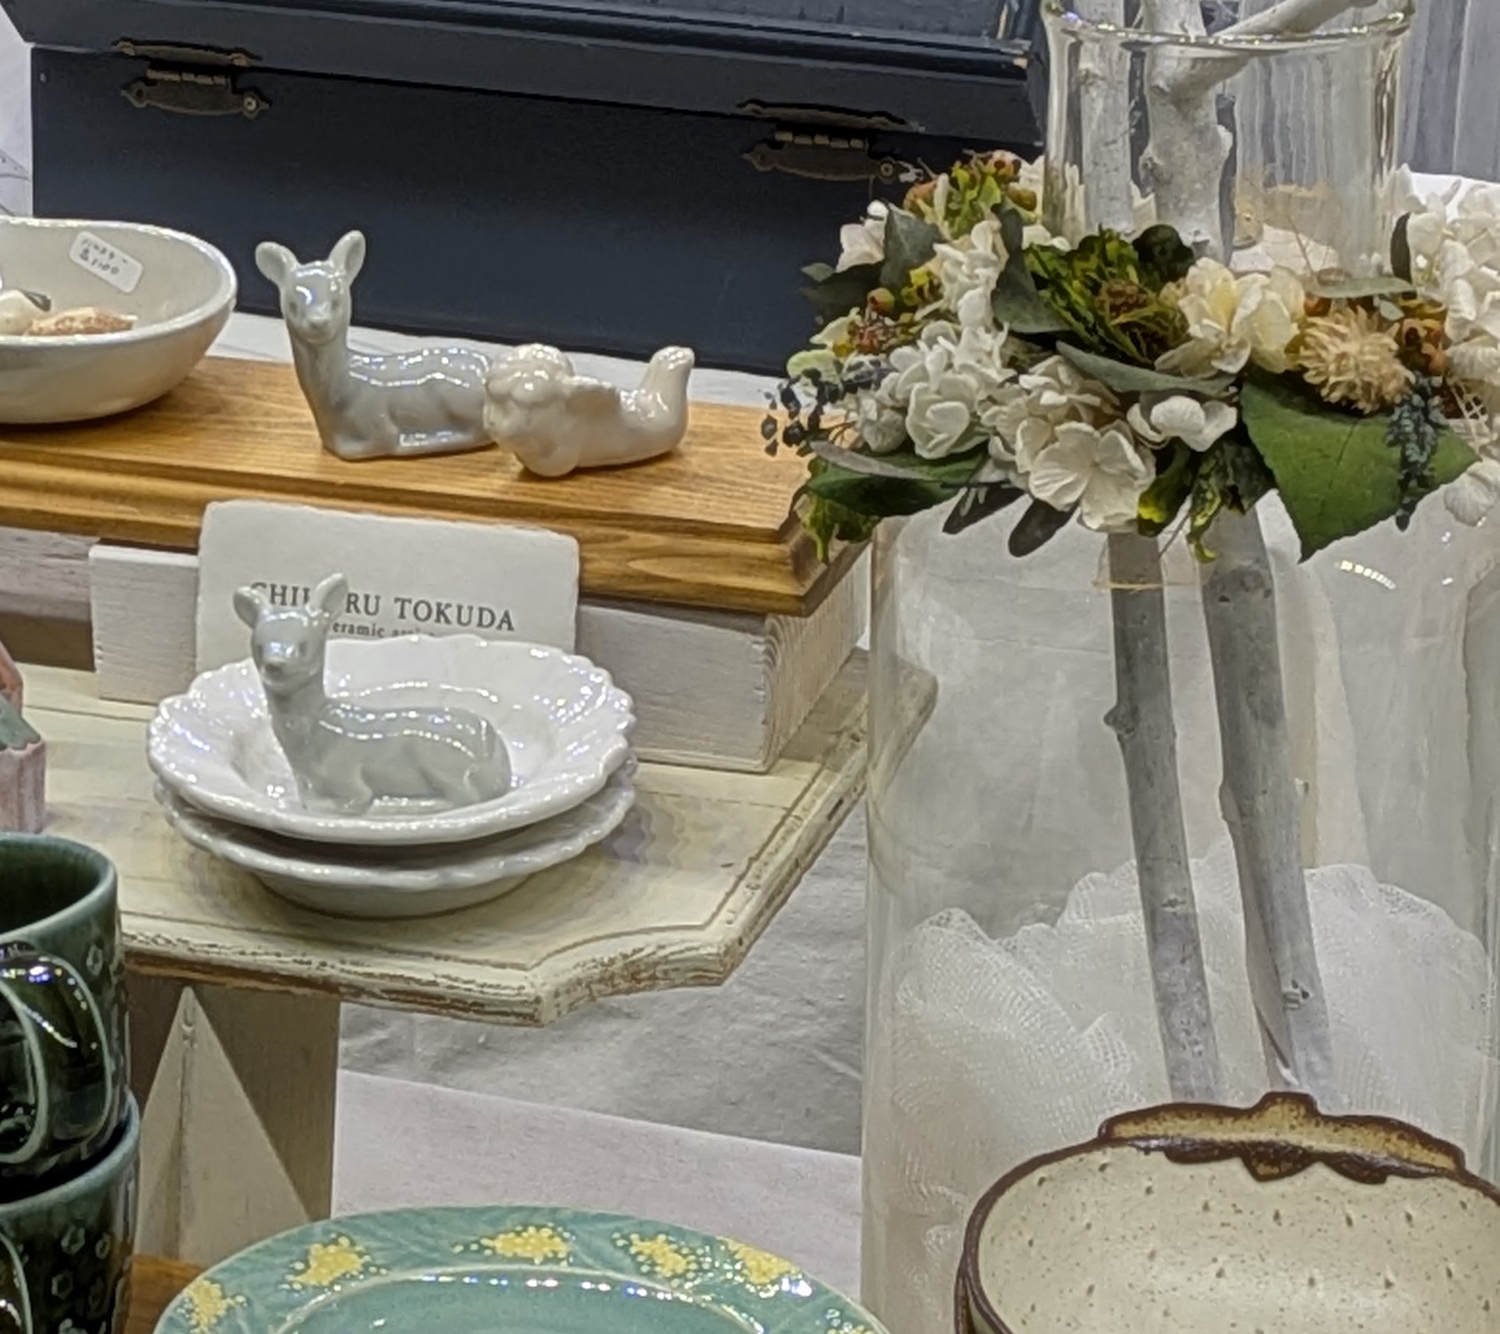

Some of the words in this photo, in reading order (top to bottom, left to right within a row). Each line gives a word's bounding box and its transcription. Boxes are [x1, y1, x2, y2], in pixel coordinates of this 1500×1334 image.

[251, 582, 381, 617] HIRU
[393, 597, 515, 632] TOKUDA
[332, 622, 385, 639] eramic
